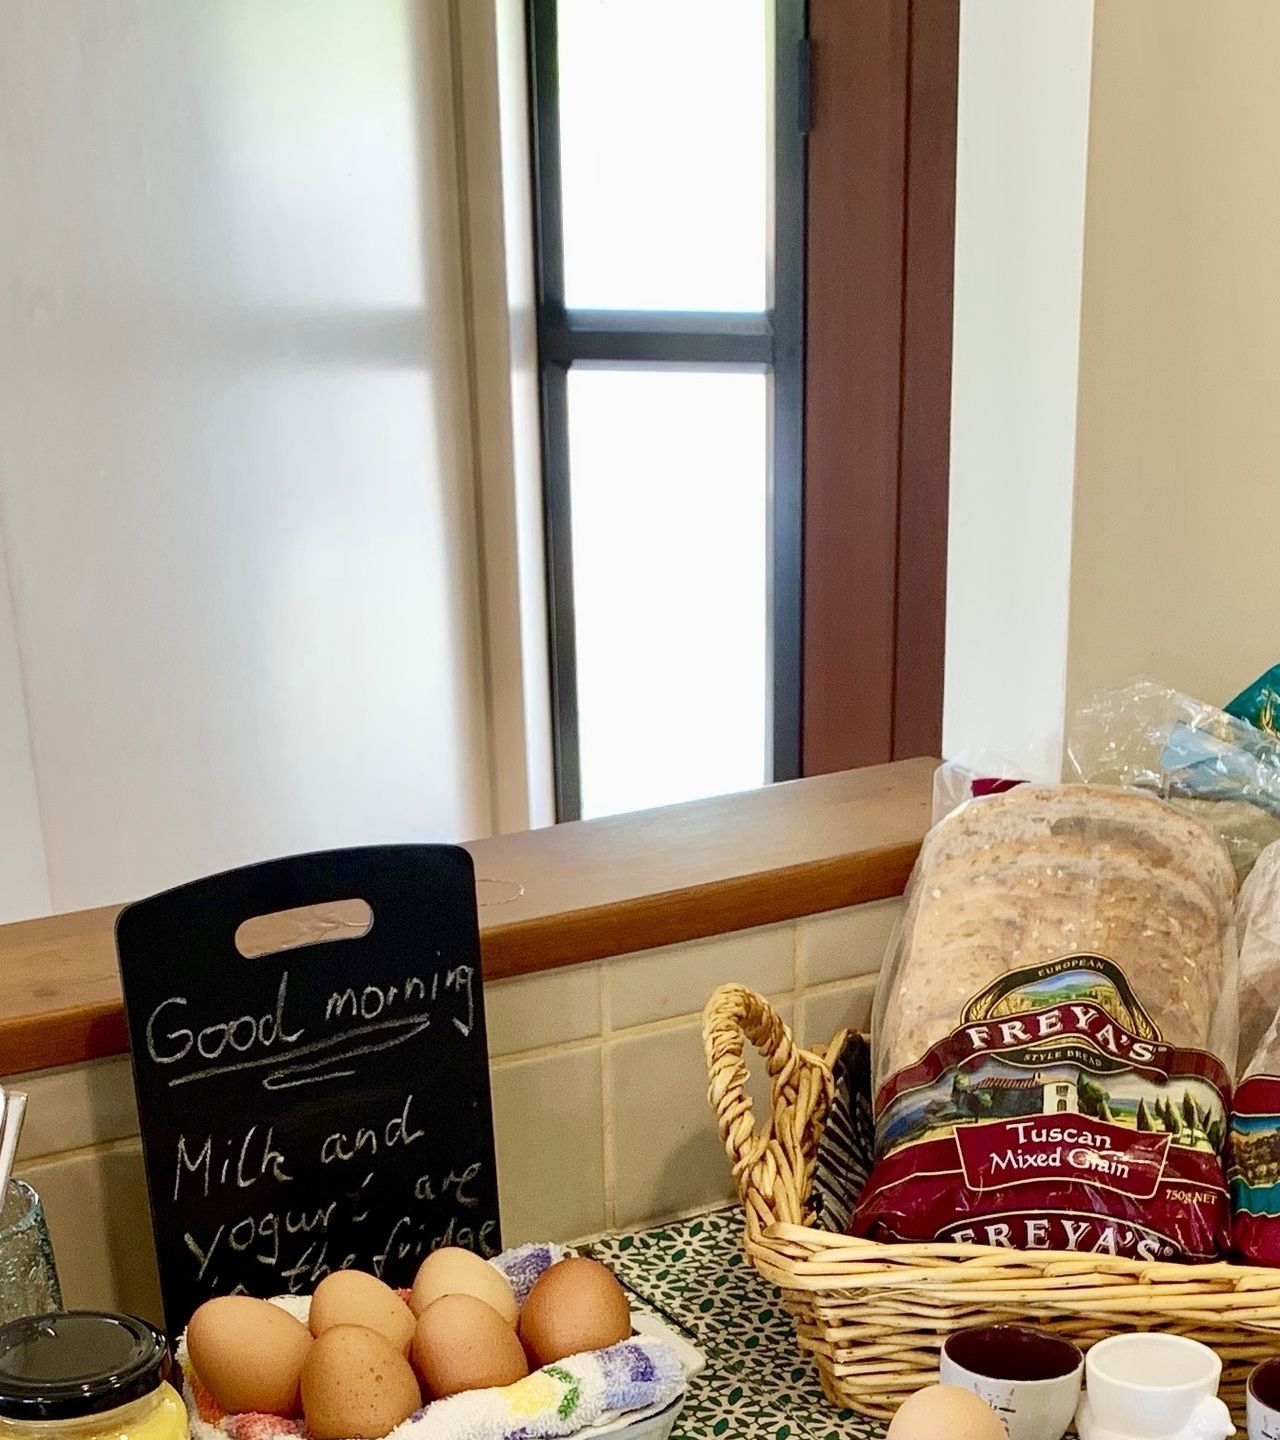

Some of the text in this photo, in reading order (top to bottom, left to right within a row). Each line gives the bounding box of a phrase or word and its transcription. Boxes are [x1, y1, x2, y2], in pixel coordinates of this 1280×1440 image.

[1037, 957, 1106, 977] EUROPEAN
[146, 951, 475, 1064] Good morning
[964, 1004, 1159, 1063] FREYA'S
[1023, 1049, 1103, 1067] STYLE BREAD
[173, 1095, 424, 1200] Milk and
[1006, 1121, 1112, 1150] Tuscan
[990, 1147, 1131, 1179] Mixed Grain
[415, 1161, 483, 1208] are
[1165, 1189, 1218, 1206] 750g NET
[281, 1241, 356, 1294] the
